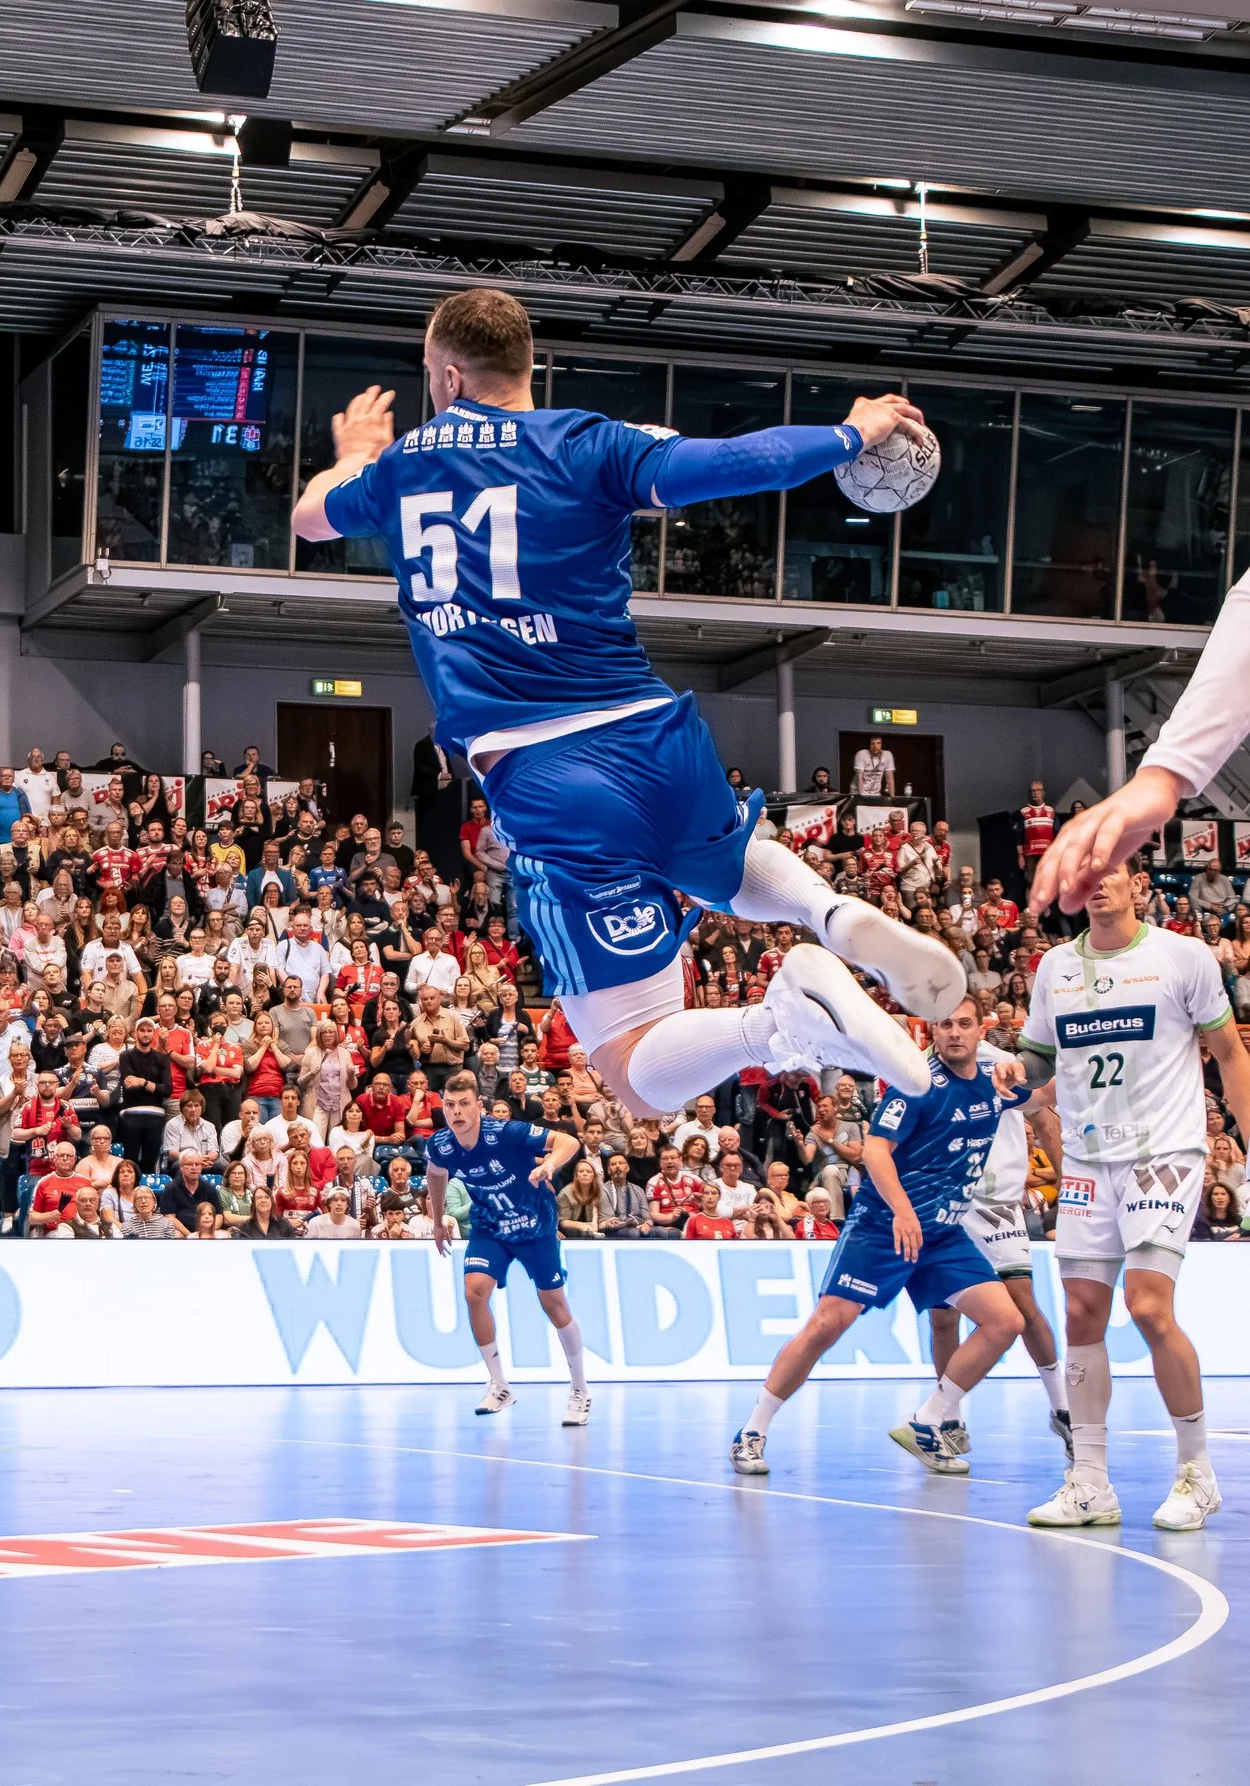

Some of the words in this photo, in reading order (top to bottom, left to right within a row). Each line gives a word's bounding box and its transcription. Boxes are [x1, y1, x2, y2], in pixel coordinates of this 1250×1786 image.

[400, 484, 522, 603] 51
[603, 906, 656, 938] Dole
[1065, 1017, 1145, 1036] Buderus
[1088, 1052, 1124, 1089] 22
[488, 1192, 515, 1211] 11
